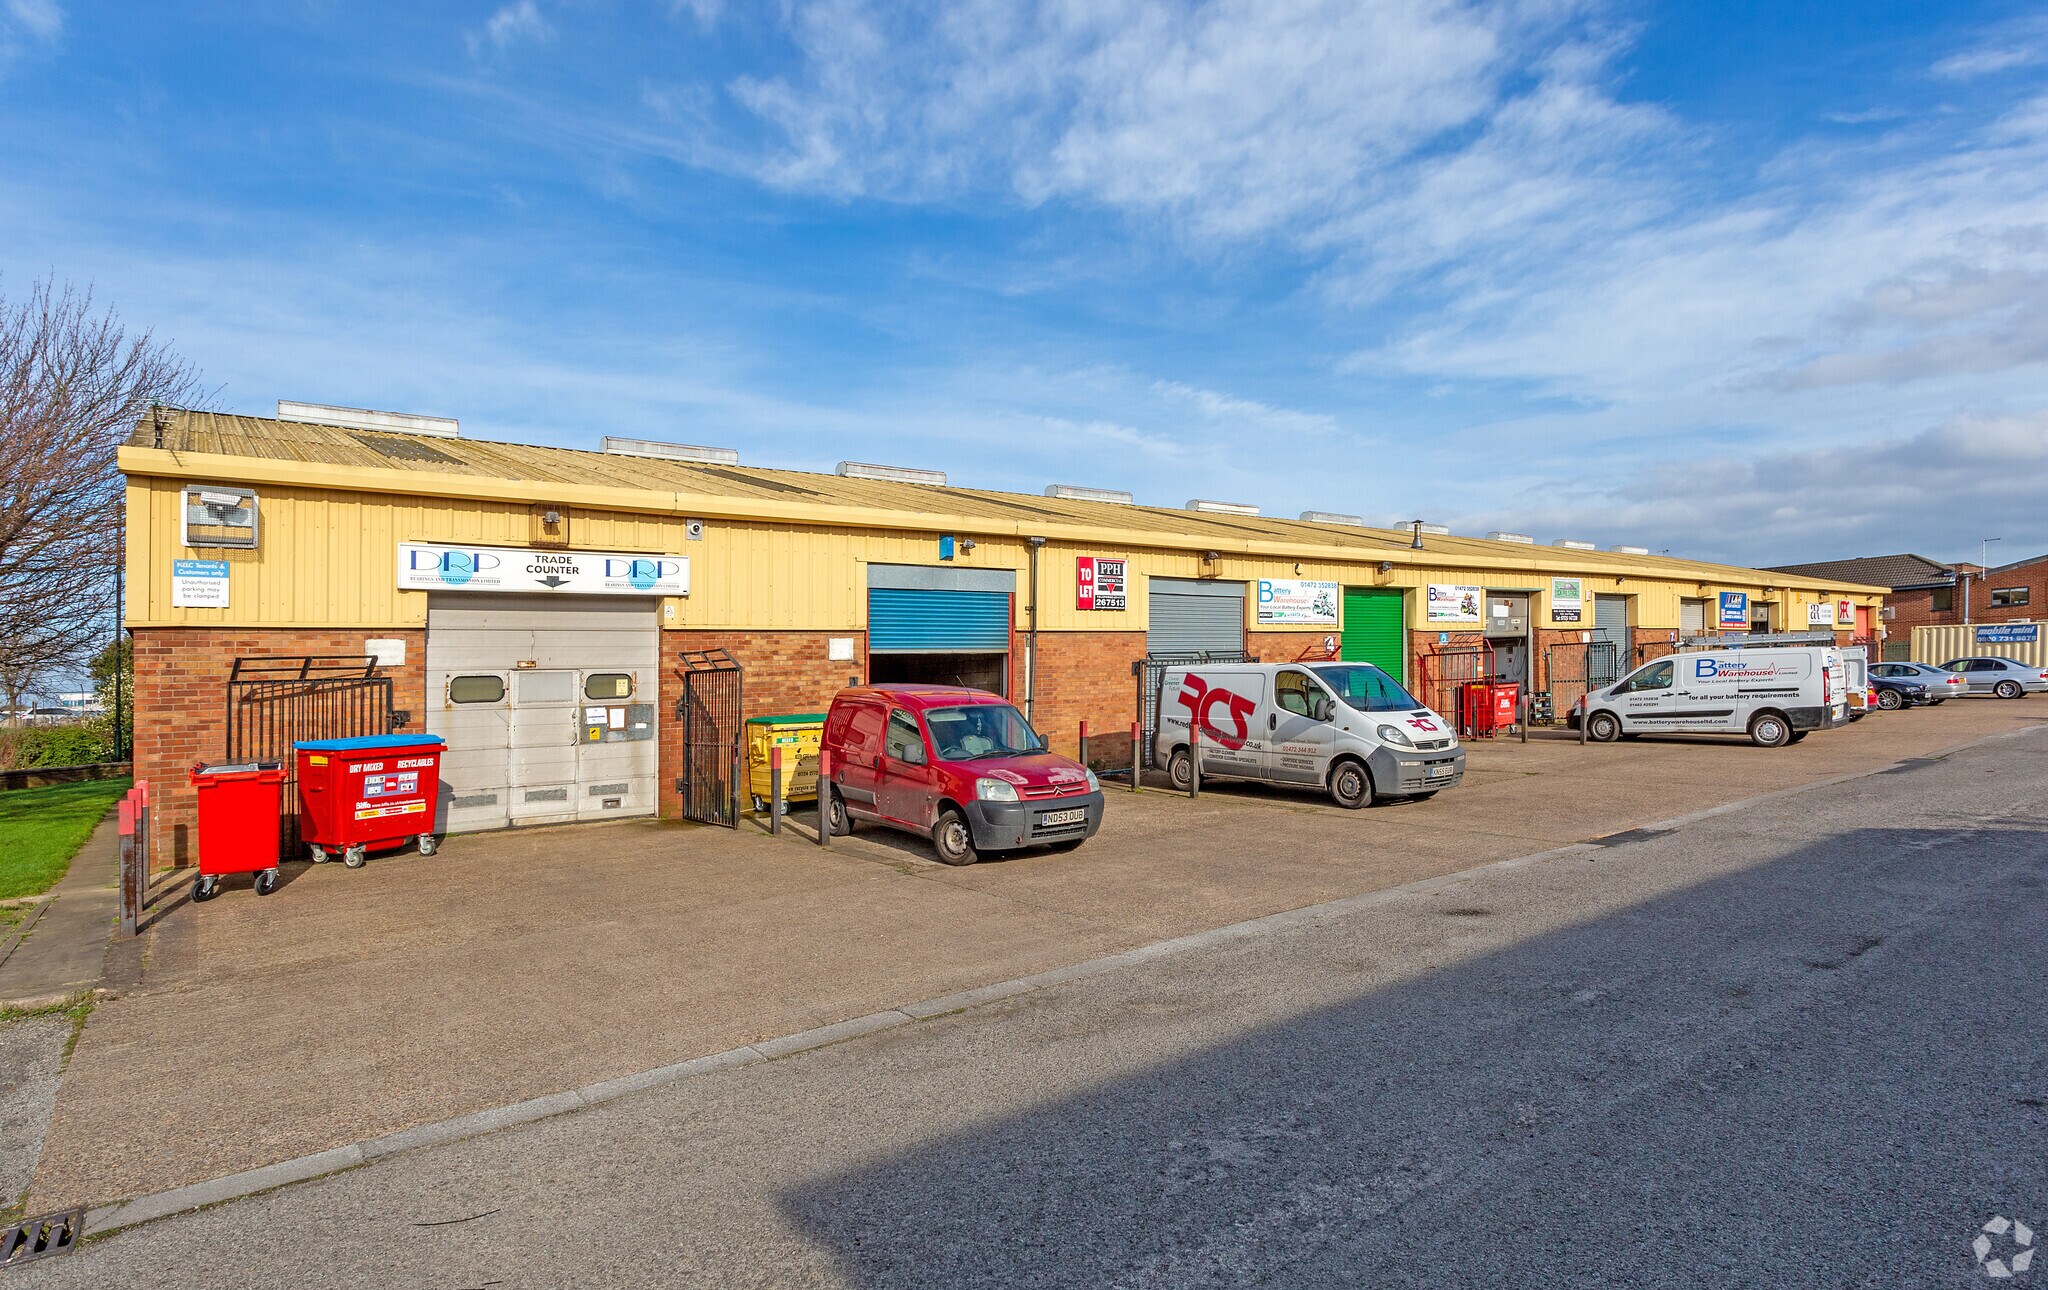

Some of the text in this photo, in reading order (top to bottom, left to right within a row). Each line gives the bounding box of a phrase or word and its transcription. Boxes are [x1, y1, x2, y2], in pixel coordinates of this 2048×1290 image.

[410, 550, 500, 573] DRP
[535, 555, 572, 564] TRADE
[526, 565, 579, 575] COUNTER
[605, 559, 680, 578] DRP
[1080, 567, 1092, 581] TO
[1100, 563, 1121, 575] PPH
[1080, 585, 1093, 598] LET
[1259, 581, 1292, 604] Battery
[1096, 599, 1125, 607] 267513
[1274, 595, 1307, 604] Warehouse
[1978, 625, 2035, 635] mobile mini
[1324, 635, 1335, 652] 4
[1695, 659, 1747, 678] Battery
[1726, 693, 1751, 701] battery
[349, 762, 384, 773] DRY MIXED
[397, 758, 434, 769] RECYCLABLES
[356, 801, 371, 810] Biffa
[1047, 812, 1068, 823] ND53
